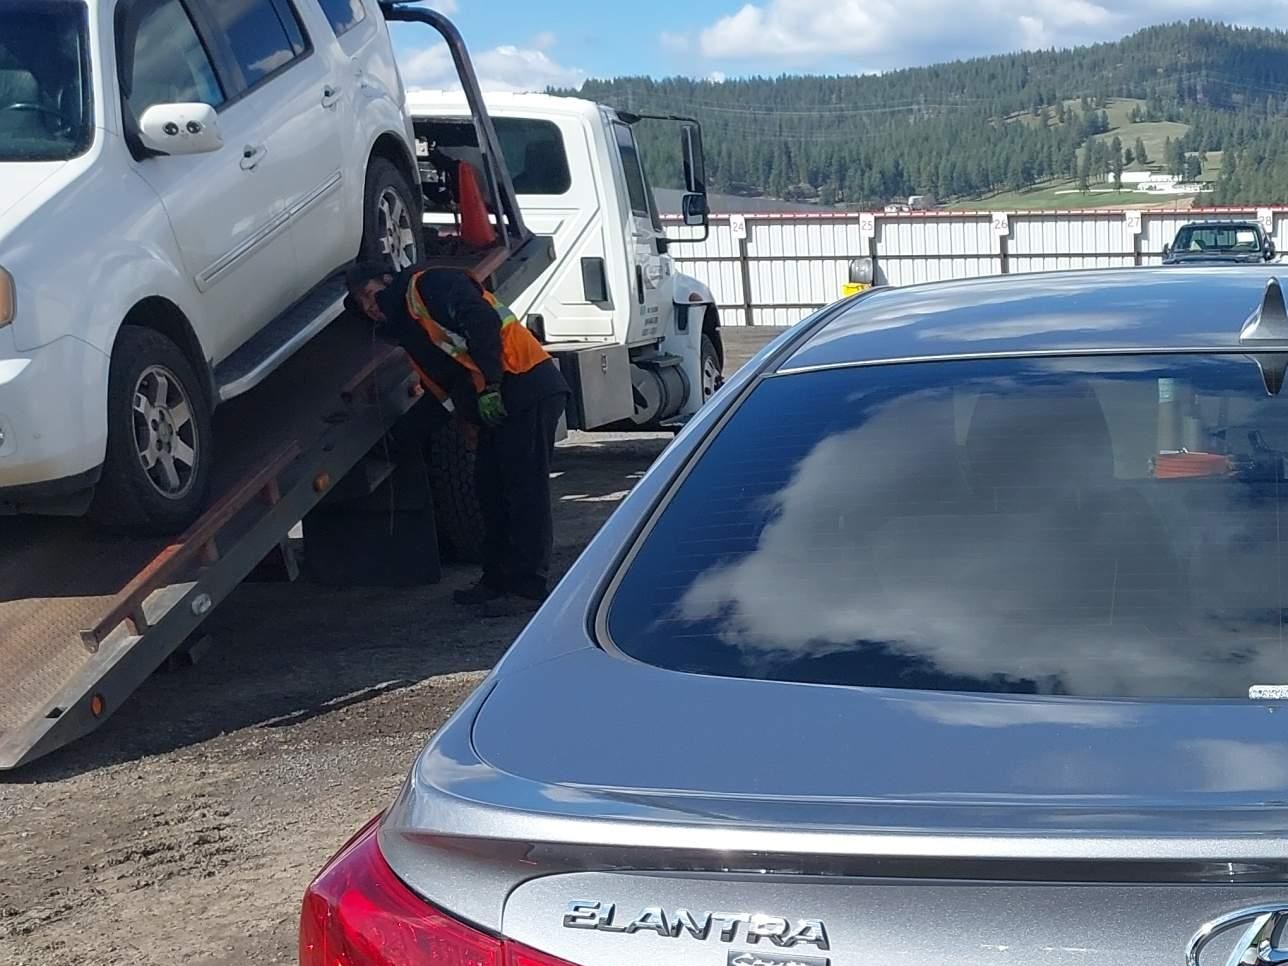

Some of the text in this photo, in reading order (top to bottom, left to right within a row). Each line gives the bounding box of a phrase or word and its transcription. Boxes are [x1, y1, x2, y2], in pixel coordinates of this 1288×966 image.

[732, 222, 744, 232] 24
[861, 220, 873, 231] 25
[994, 219, 1007, 230] 26
[1127, 216, 1141, 227] 27
[563, 900, 831, 951] ELANTRA
